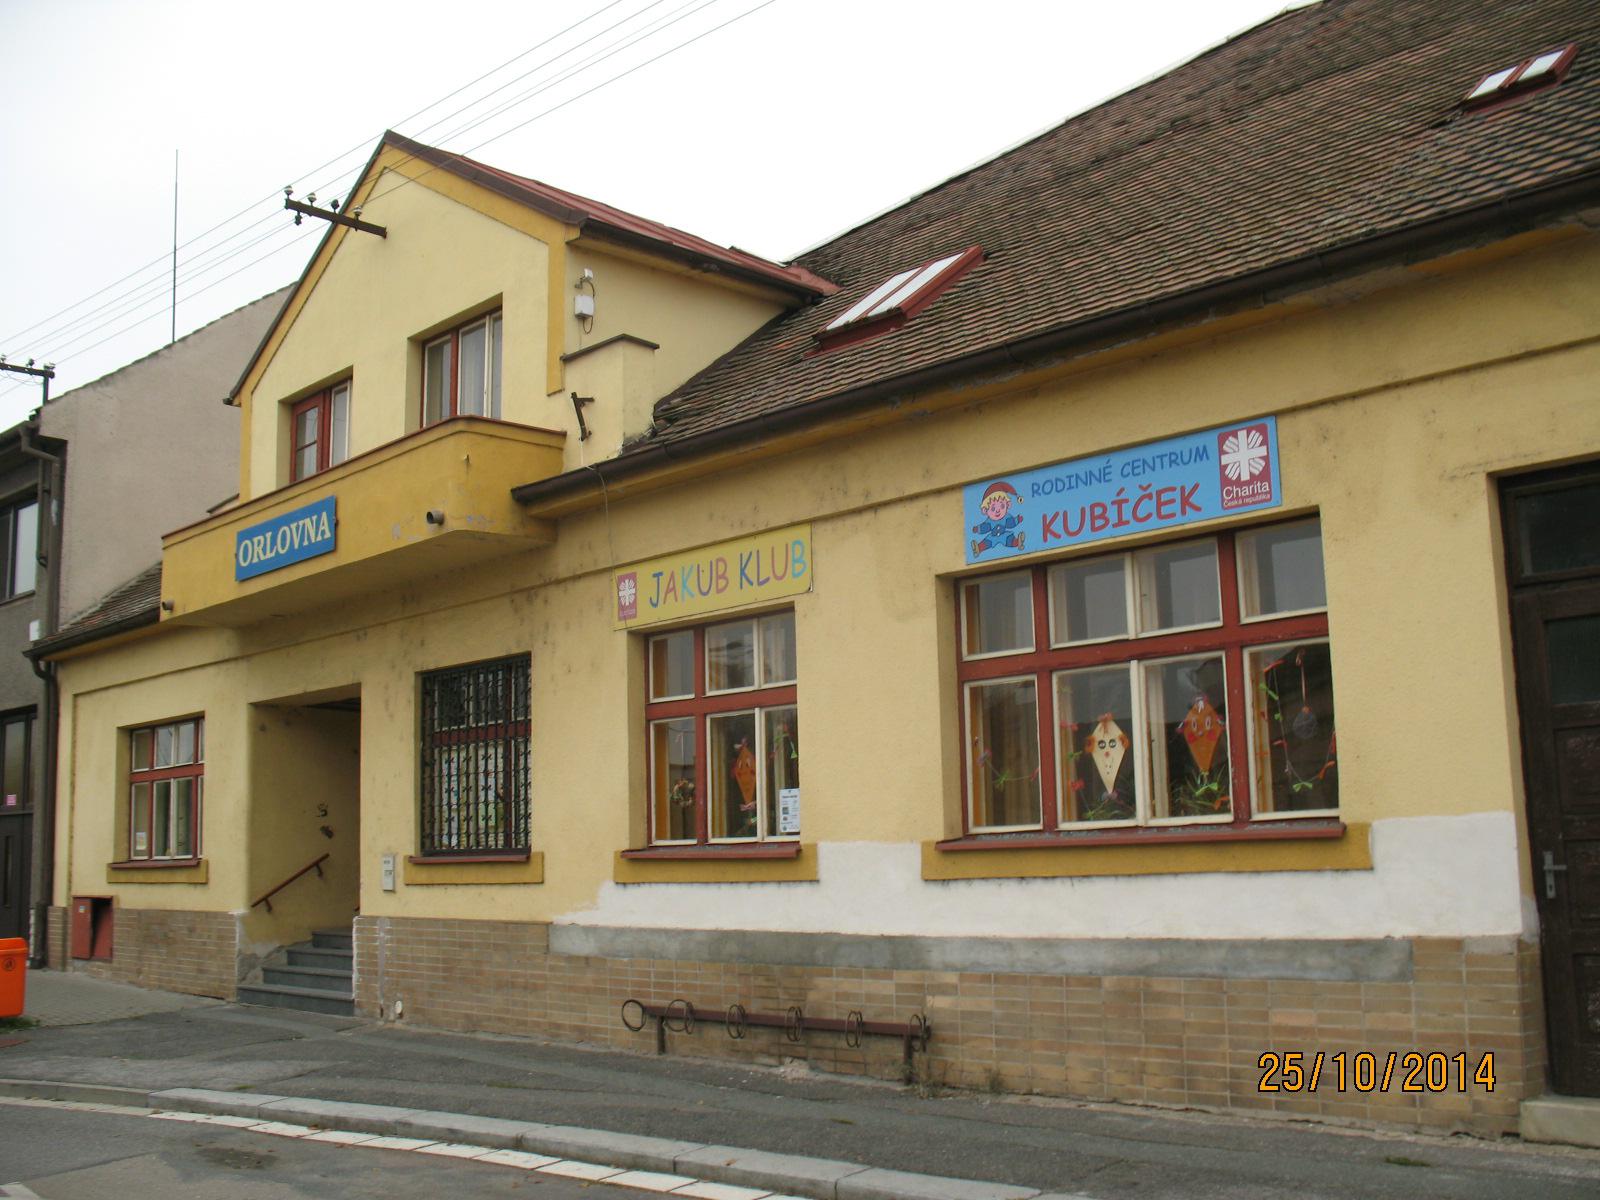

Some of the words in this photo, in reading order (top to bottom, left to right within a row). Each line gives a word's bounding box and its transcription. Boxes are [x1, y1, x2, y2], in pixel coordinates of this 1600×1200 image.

[1031, 461, 1113, 498] RODINNÉ
[1120, 445, 1210, 479] CENTRUM
[1223, 481, 1270, 500] Charita
[239, 511, 331, 567] ORLOVNA
[1041, 481, 1203, 543] KUBÍČEK
[649, 556, 730, 609] JAKUB
[739, 539, 808, 590] KLUB
